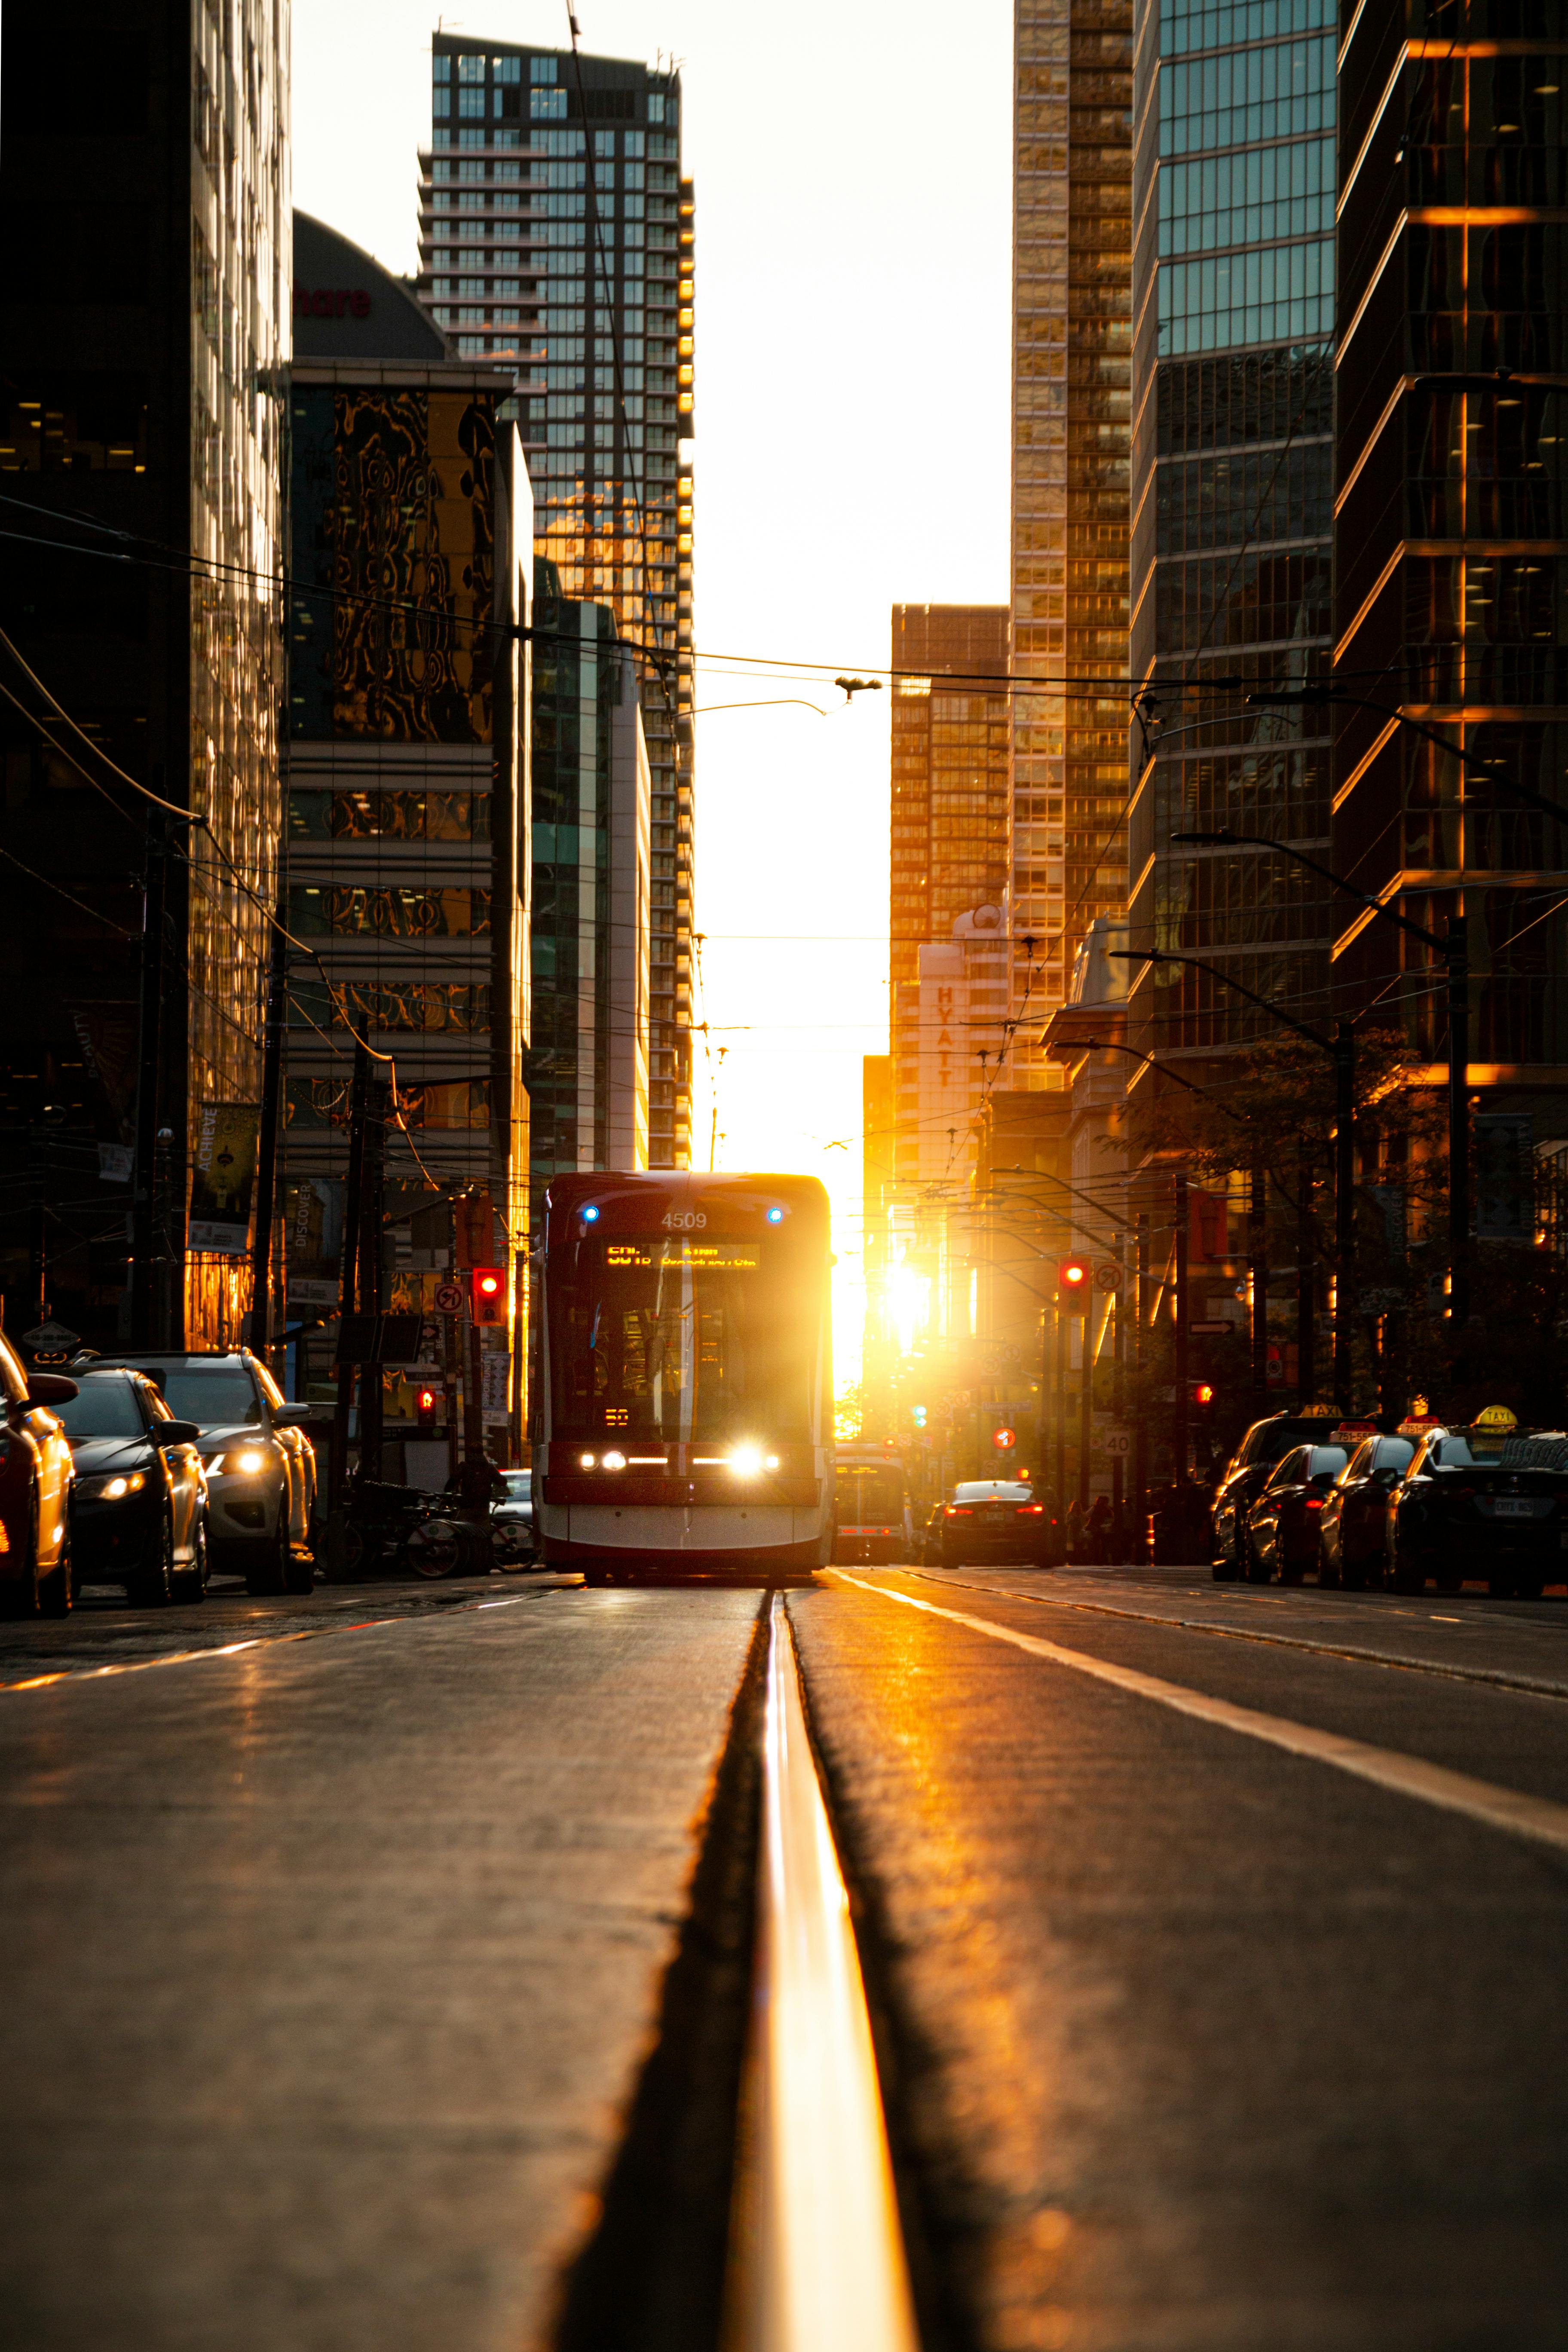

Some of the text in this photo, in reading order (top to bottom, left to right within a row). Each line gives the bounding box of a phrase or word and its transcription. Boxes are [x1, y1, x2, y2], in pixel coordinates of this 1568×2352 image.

[937, 986, 952, 1087] HYATT
[199, 1108, 217, 1172] ACHIEVE
[296, 1184, 311, 1247] DISCOVER
[662, 1213, 707, 1228] 4509
[1307, 1406, 1339, 1416] TAXI
[1488, 1411, 1510, 1421] TAXI
[1107, 1437, 1129, 1451] 40
